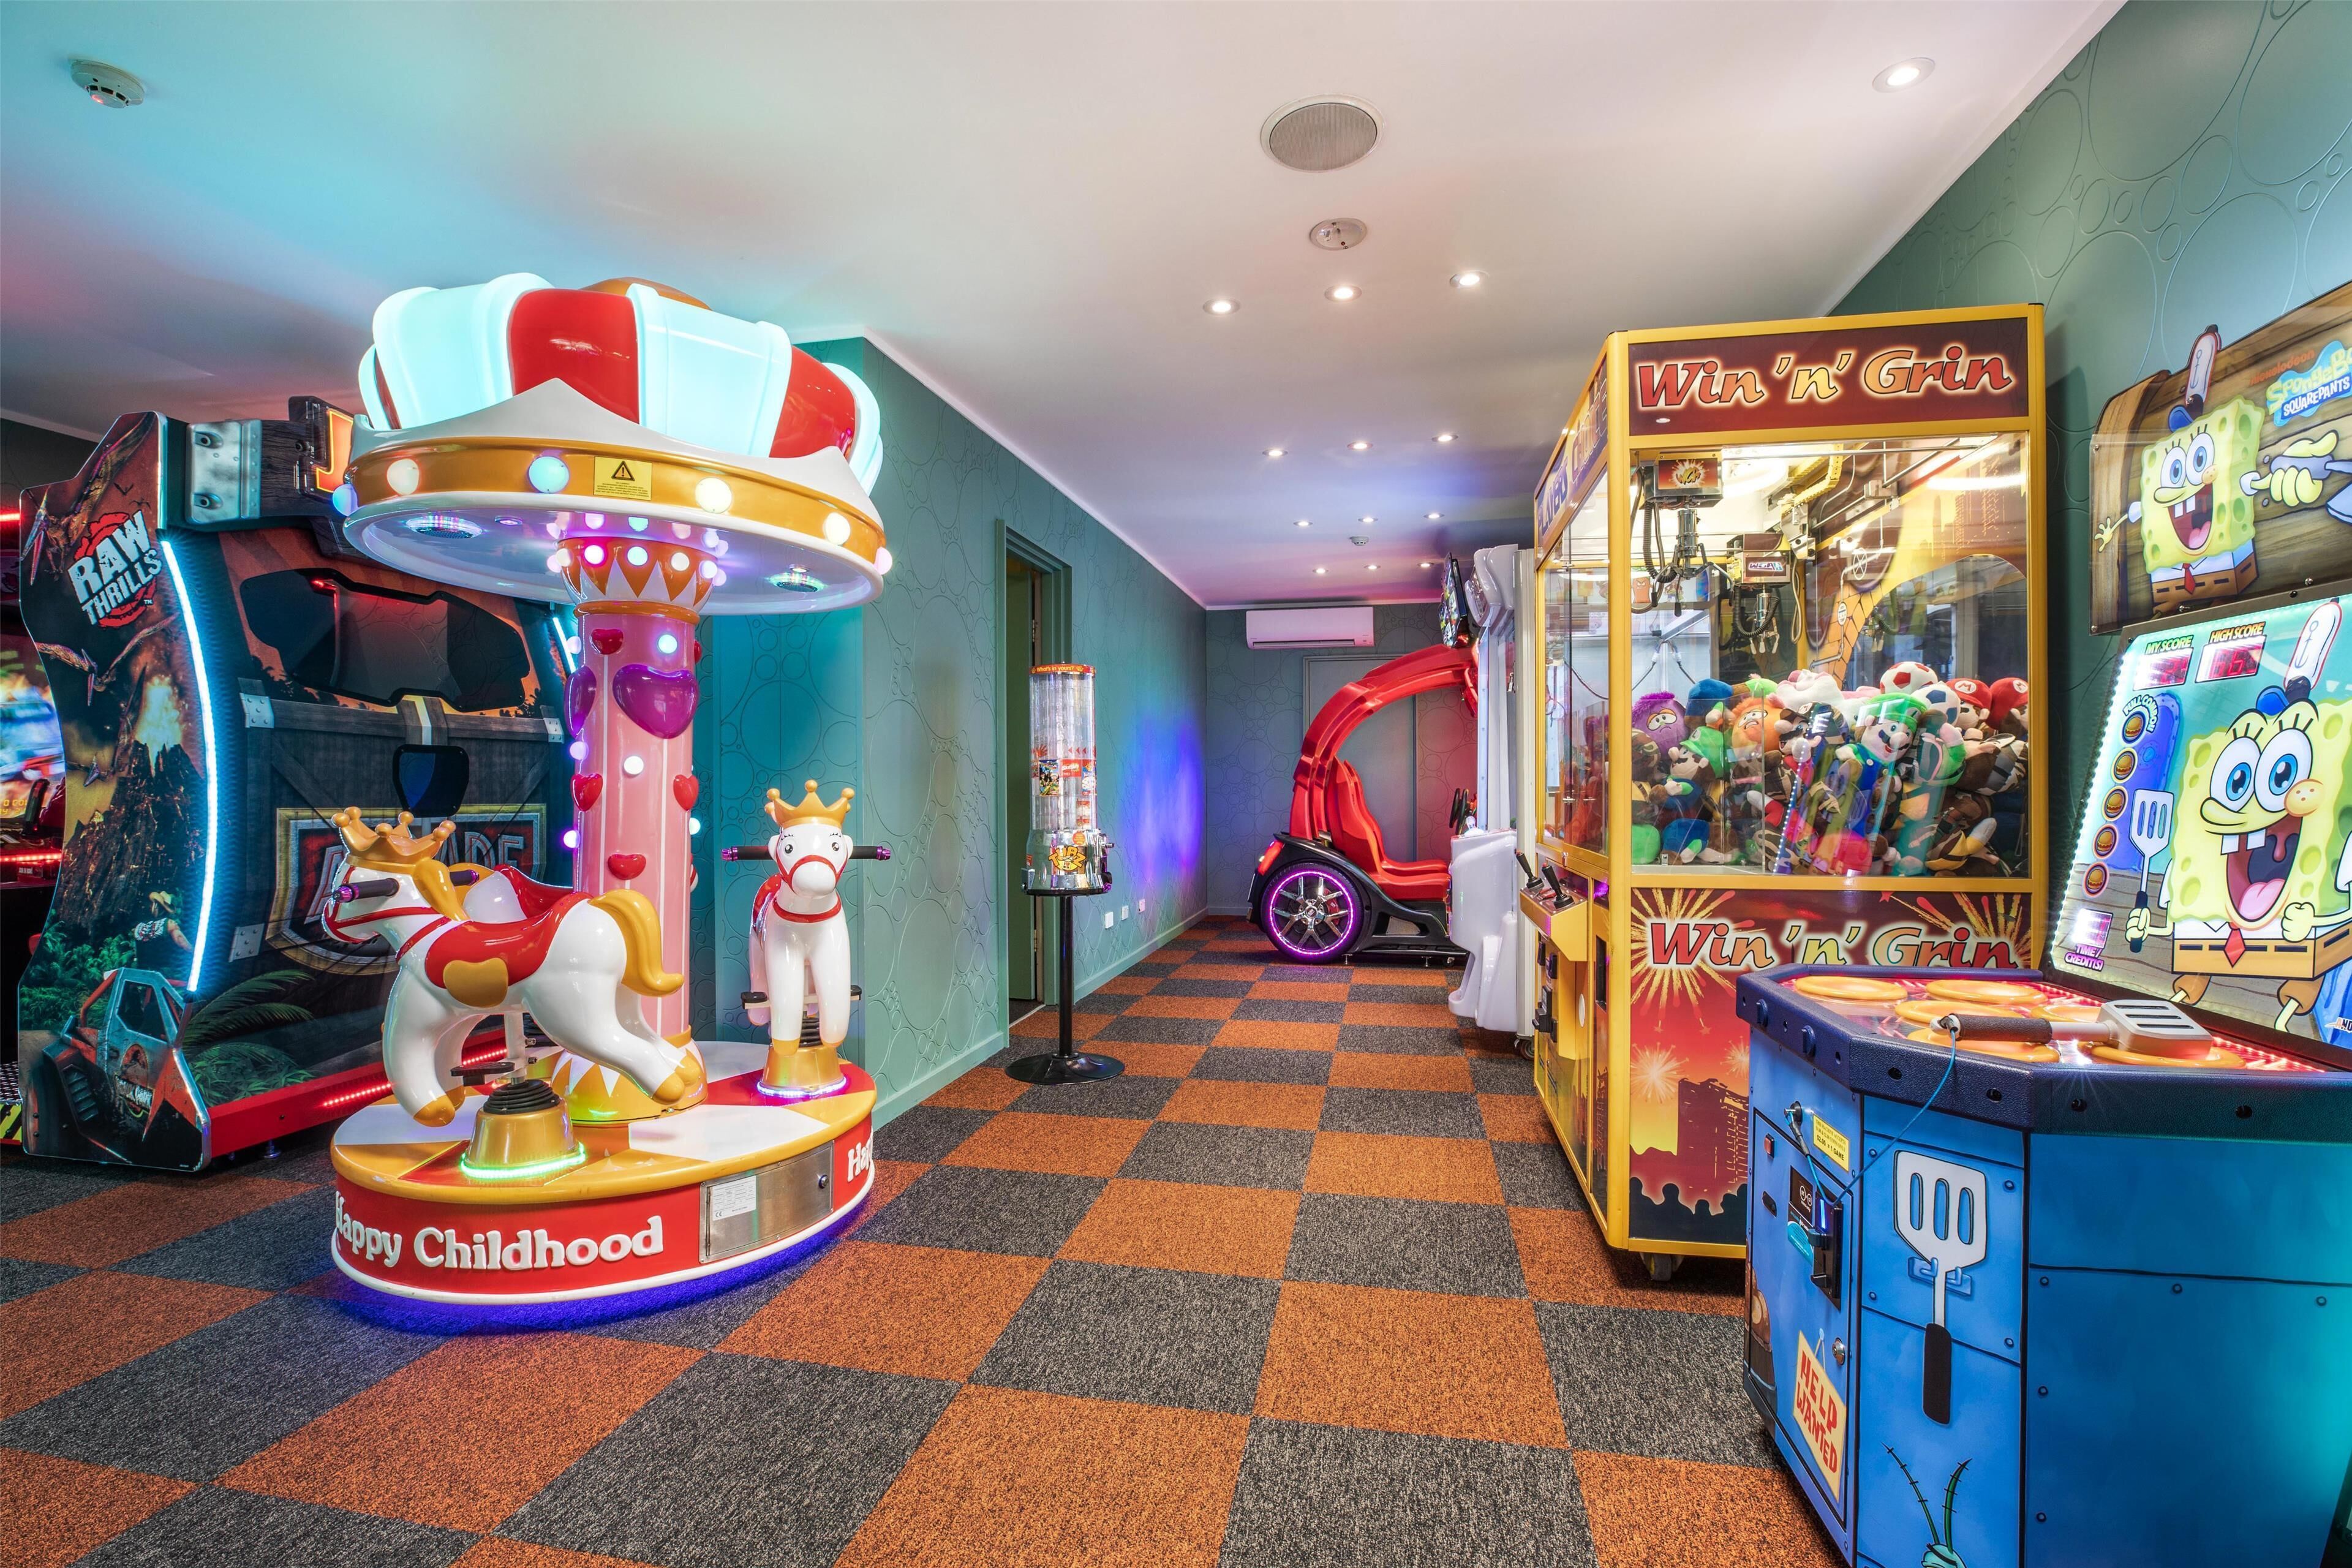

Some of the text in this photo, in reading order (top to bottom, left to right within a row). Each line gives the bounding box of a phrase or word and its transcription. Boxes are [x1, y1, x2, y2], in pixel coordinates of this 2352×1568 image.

[1638, 360, 1765, 408] Win
[1864, 346, 2013, 394] Grin
[2283, 375, 2350, 417] SQUAREPANTS
[67, 510, 151, 604] RAW
[81, 549, 162, 625] THRILLS
[2145, 635, 2194, 655] MY SCORE
[2209, 621, 2266, 644] HIGH SCORE
[2122, 695, 2142, 717] FULL
[1048, 846, 1087, 869] TUBZ
[1650, 922, 1774, 967] Win
[1872, 926, 2019, 969] Grin
[1833, 1148, 1844, 1161] GAME
[336, 1190, 664, 1271] Happy Childhood
[1800, 1349, 1838, 1435] HELP
[1796, 1381, 1838, 1474] WANTED
